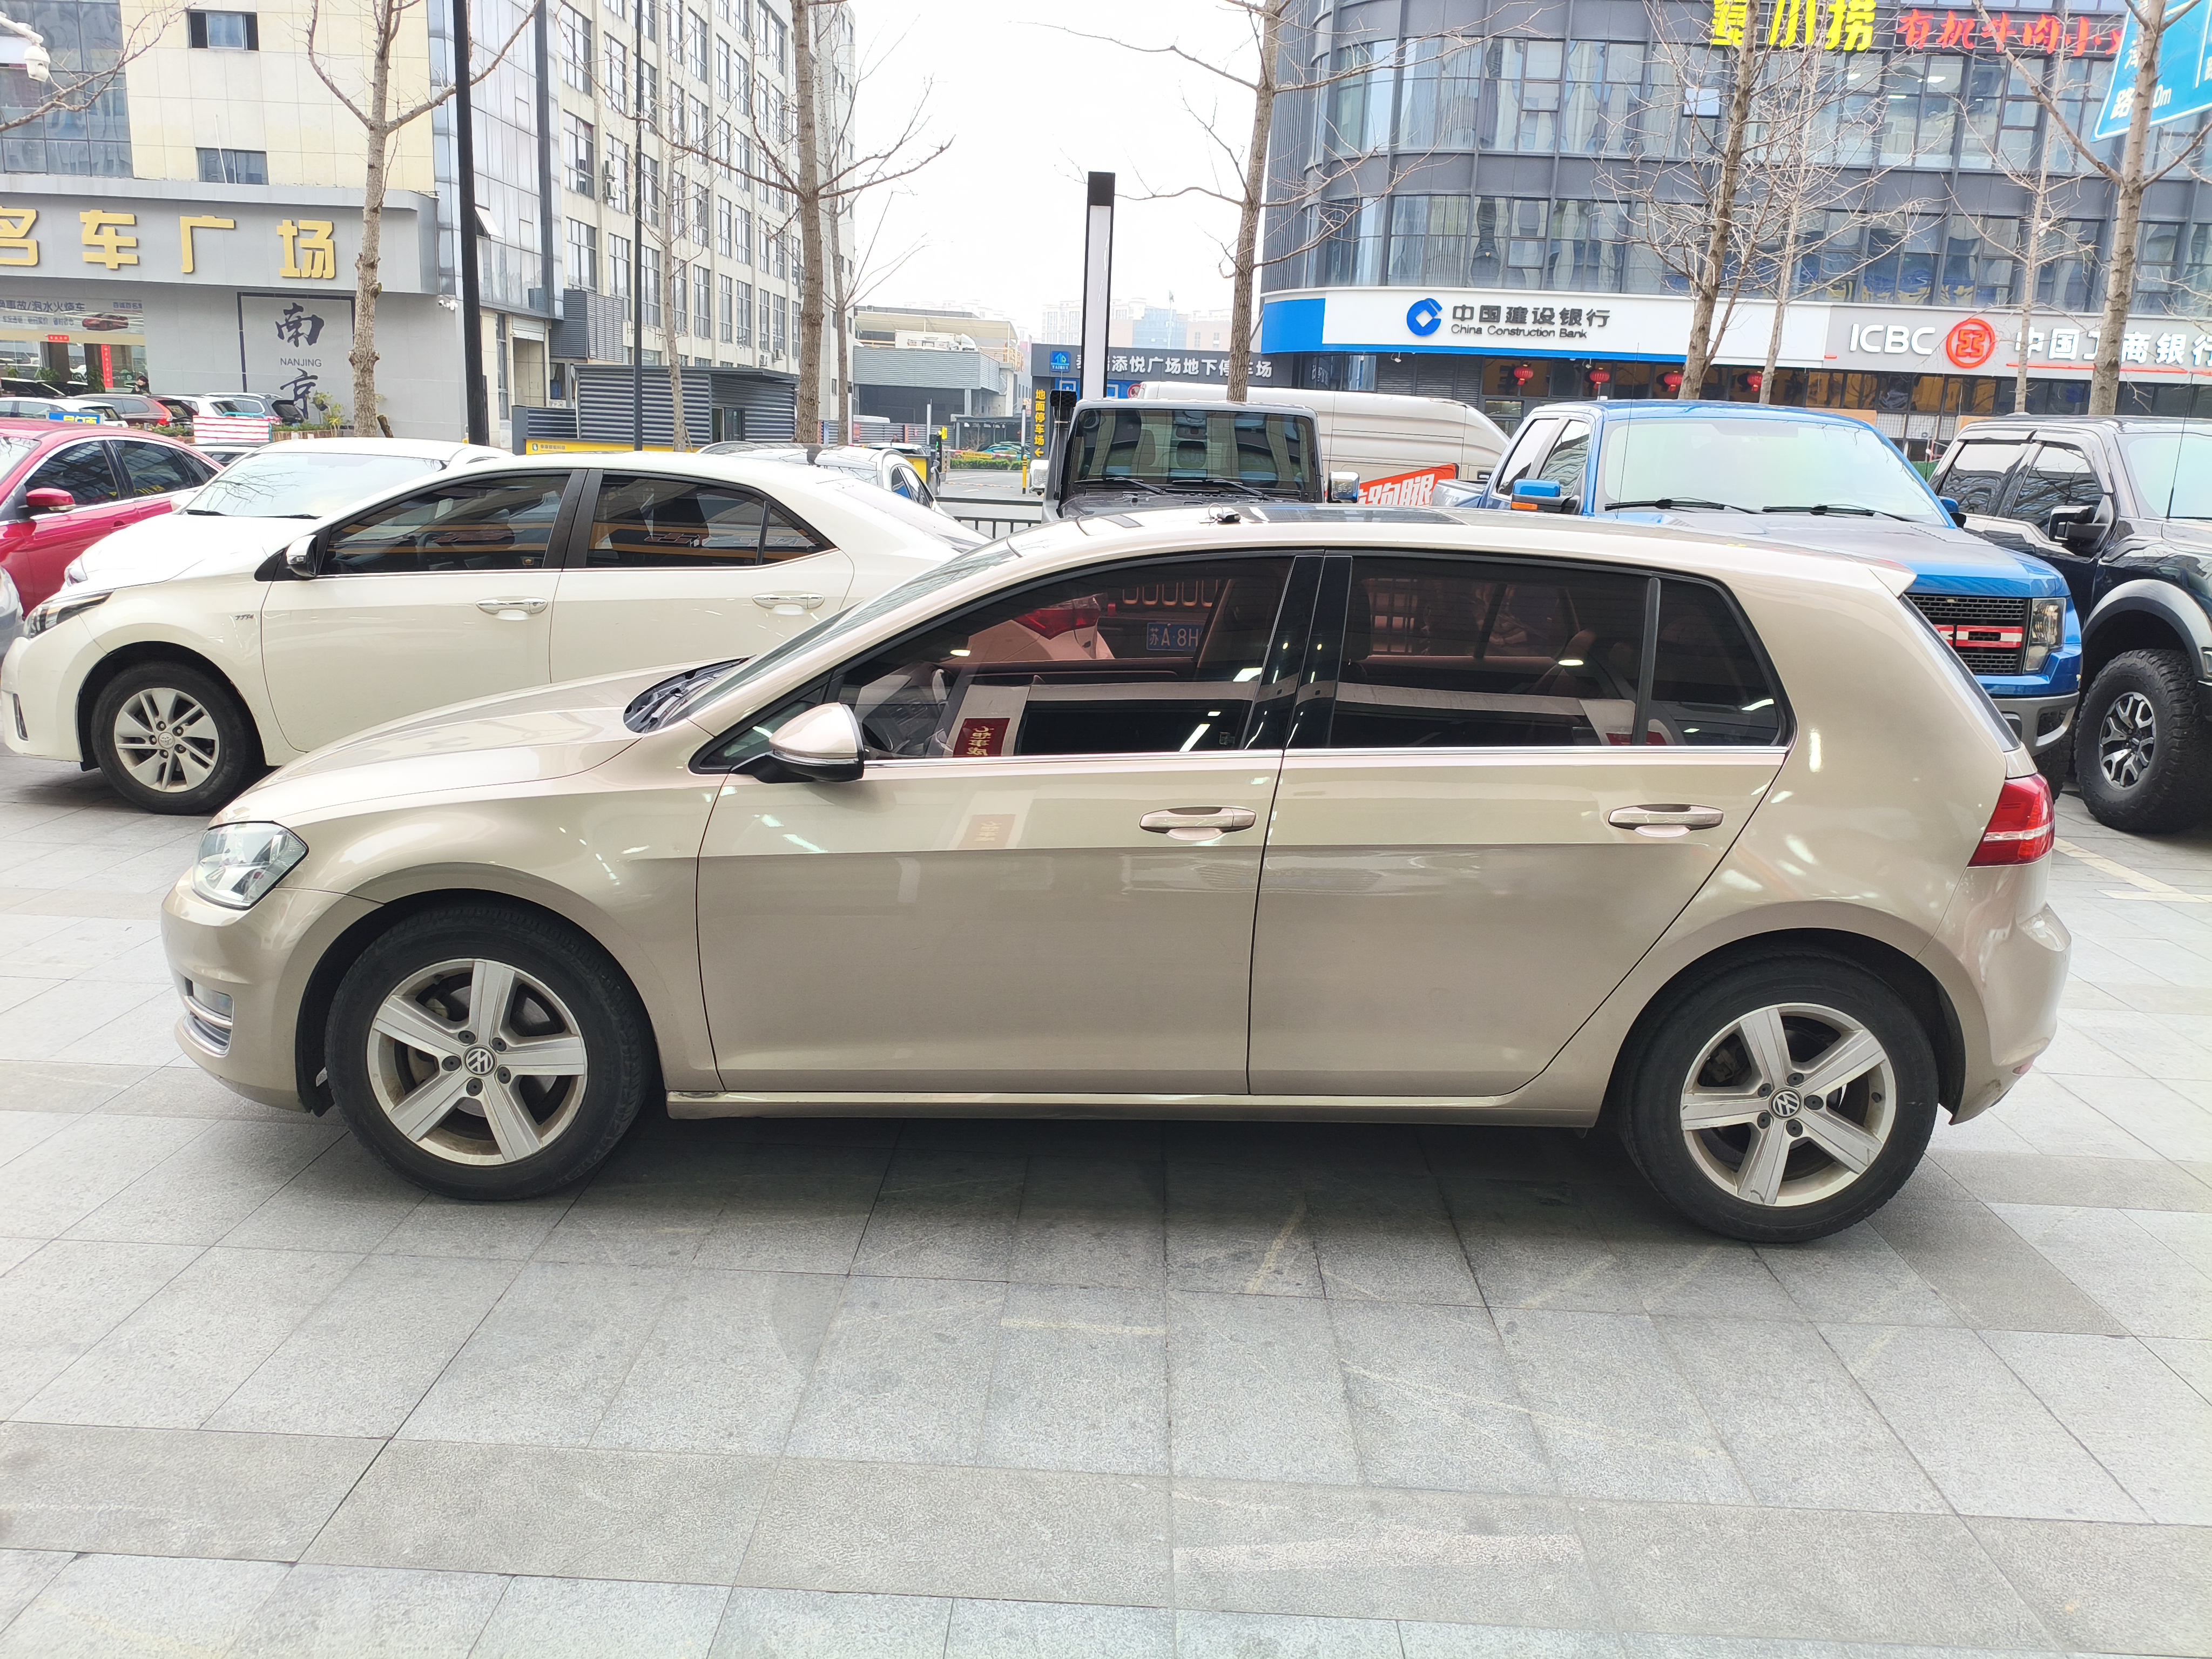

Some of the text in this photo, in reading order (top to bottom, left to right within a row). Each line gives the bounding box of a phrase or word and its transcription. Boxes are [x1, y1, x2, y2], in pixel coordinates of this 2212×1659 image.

[0, 205, 336, 279] 名车广场
[275, 302, 324, 347] 南
[1452, 304, 1610, 327] 中国建设银行
[1451, 323, 1587, 338] China Construction Bank
[1850, 323, 1936, 355] ICBC
[280, 358, 322, 367] NANJING
[1076, 354, 1272, 377] 添悦广场地下停场
[1034, 389, 1046, 446] 地面停车场
